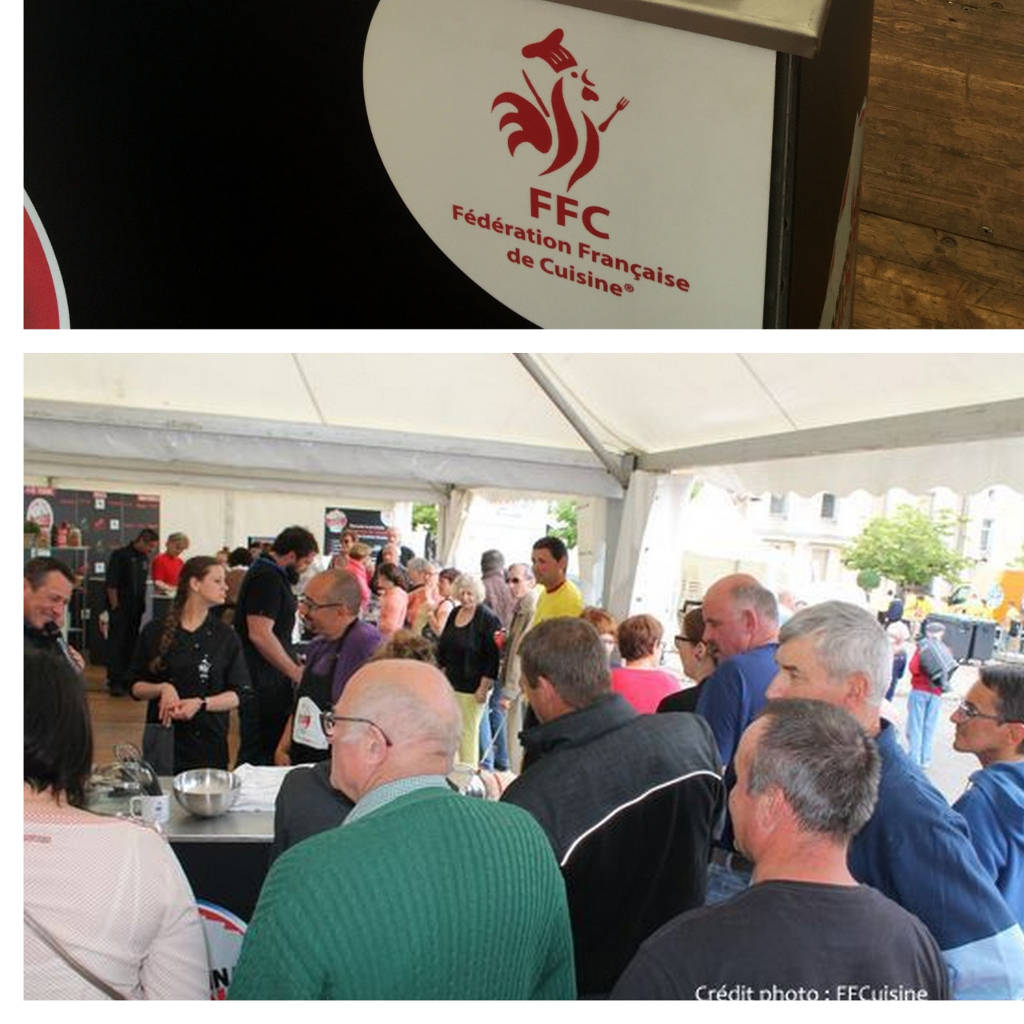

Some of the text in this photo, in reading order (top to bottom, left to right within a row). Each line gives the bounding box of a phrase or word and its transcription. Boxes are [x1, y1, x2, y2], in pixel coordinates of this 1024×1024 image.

[530, 187, 610, 240] FFC
[452, 204, 691, 292] Fédération Française
[507, 248, 535, 269] de
